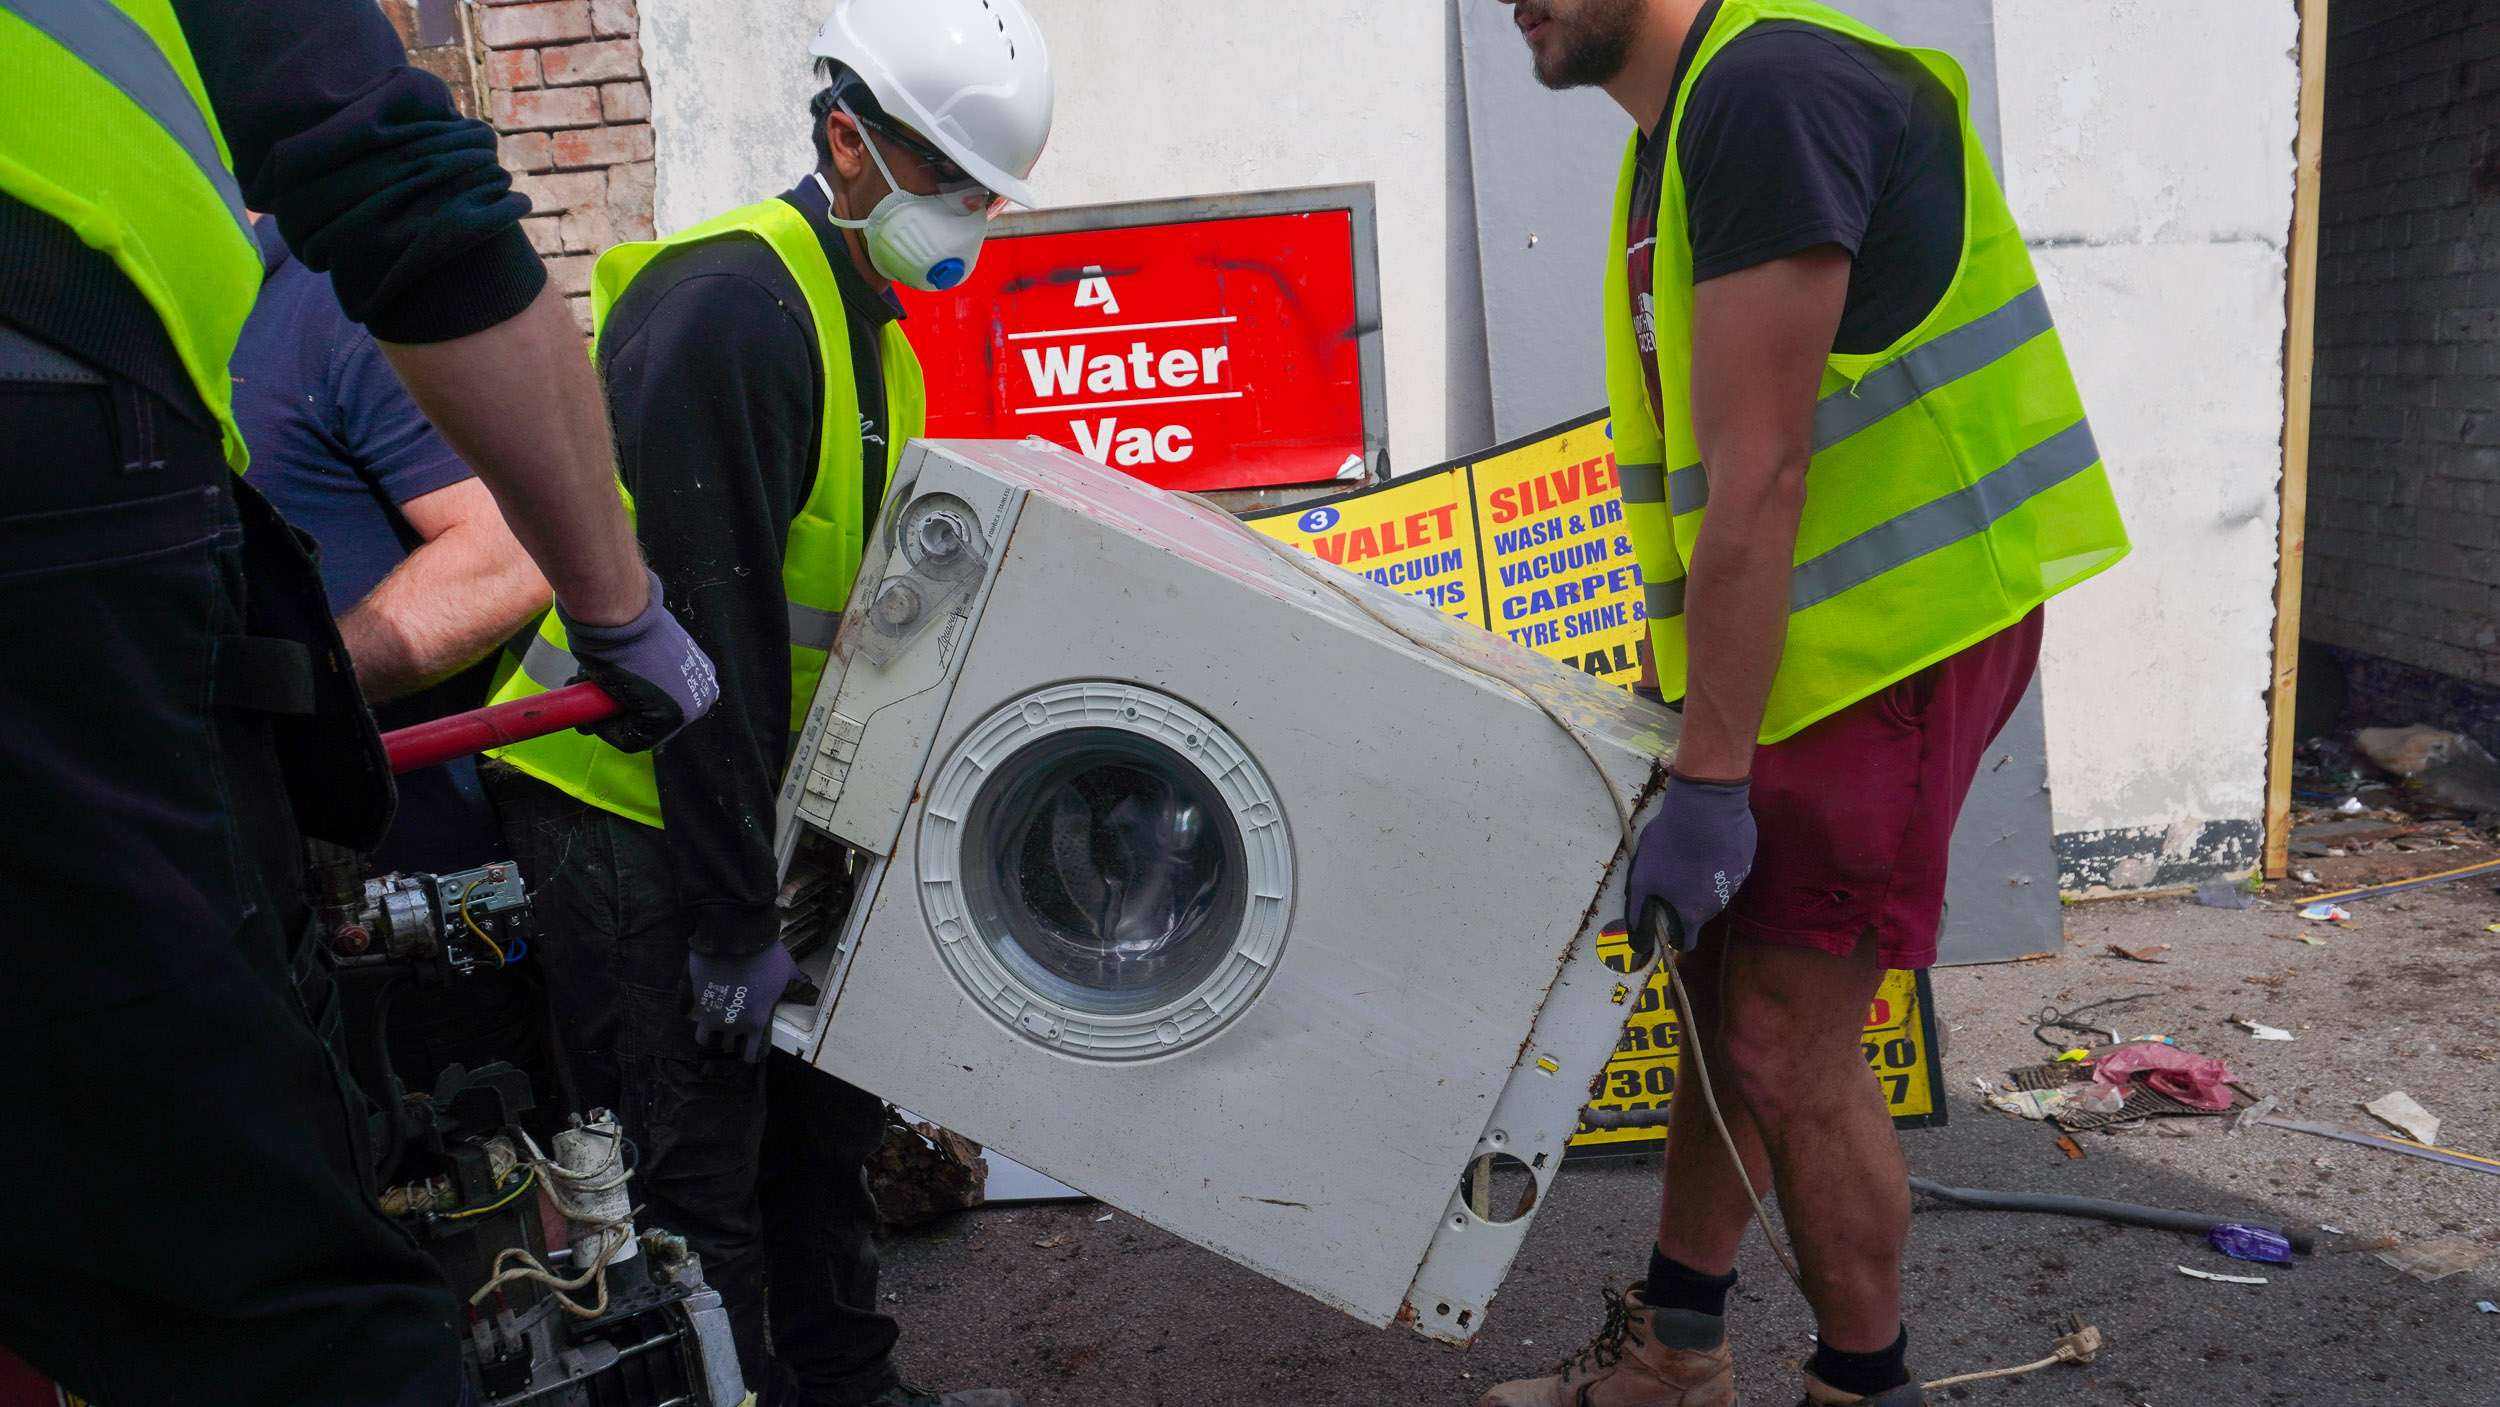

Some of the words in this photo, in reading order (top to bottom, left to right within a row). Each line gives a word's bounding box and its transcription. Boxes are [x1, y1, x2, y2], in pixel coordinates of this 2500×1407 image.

[1021, 341, 1228, 397] Water
[1070, 417, 1194, 467] Vac
[1310, 510, 1329, 530] 3
[1313, 503, 1458, 565] VALET
[1494, 517, 1563, 556] WASH
[1568, 514, 1586, 535] &
[1589, 499, 1623, 529] DR
[1499, 538, 1607, 587] VACUUM
[1614, 536, 1633, 557] &
[1508, 619, 1561, 648] TYRE
[1564, 602, 1628, 639] SHINE
[1632, 601, 1648, 621] &
